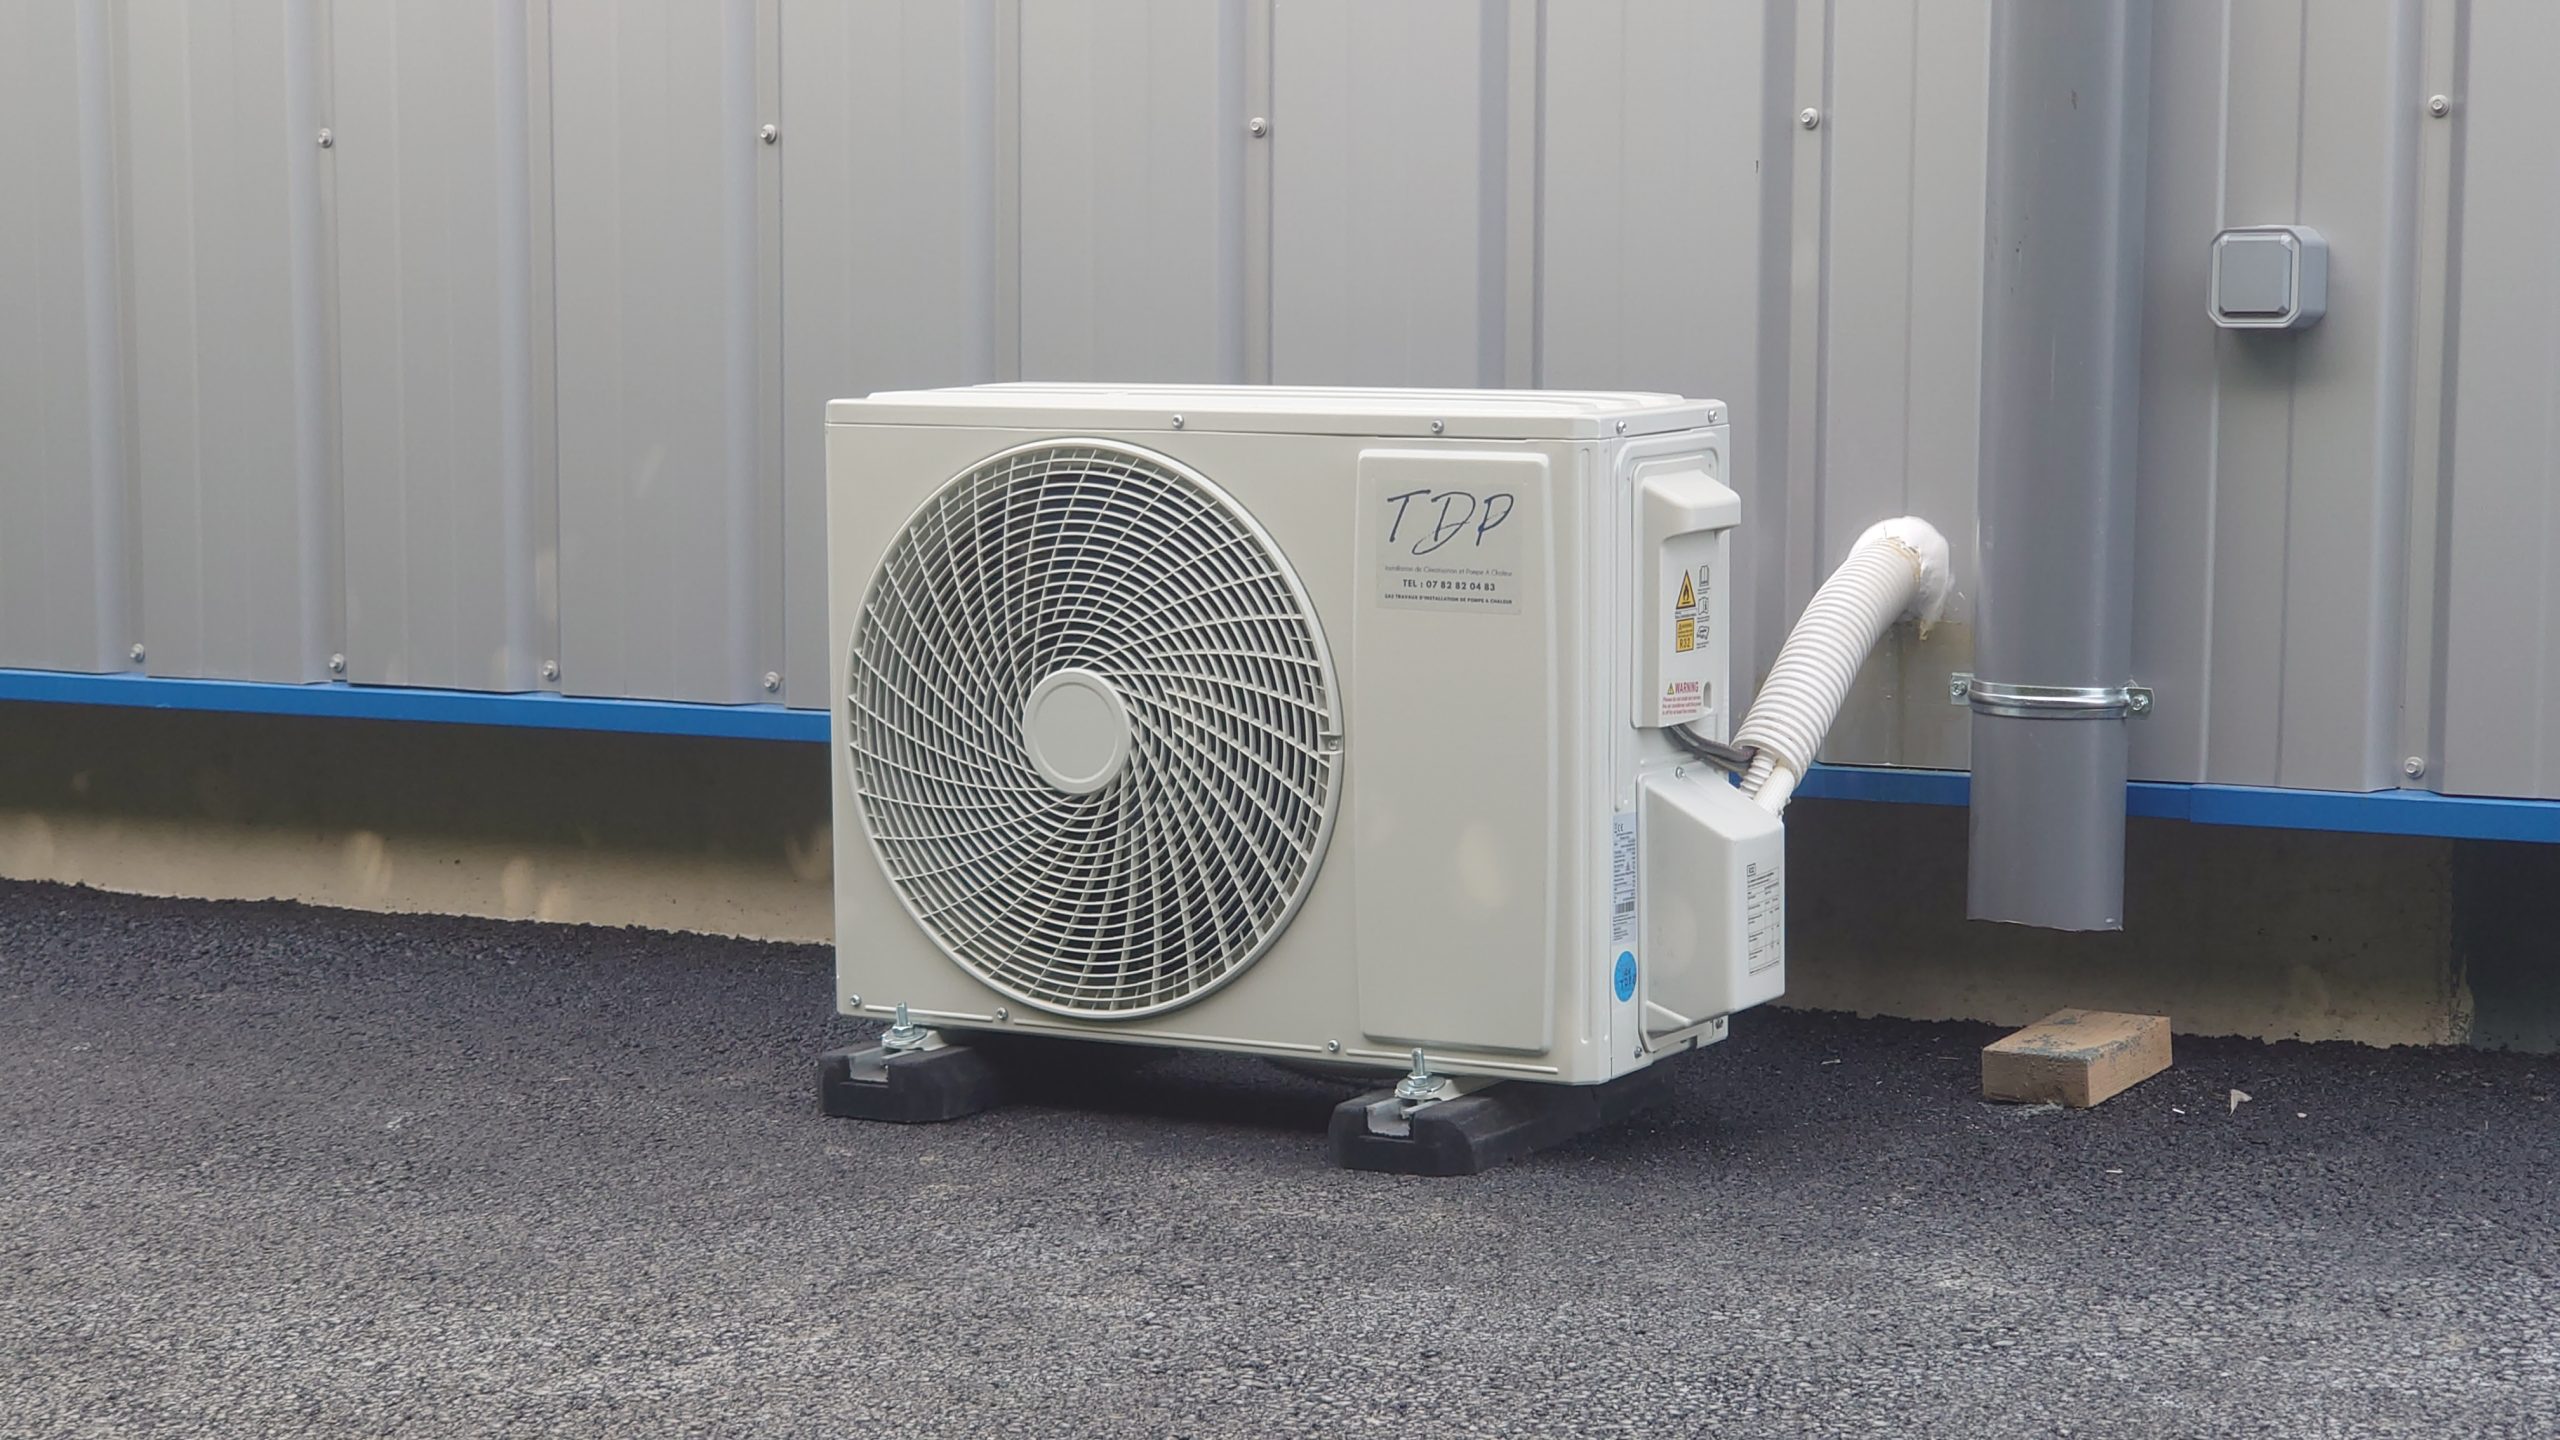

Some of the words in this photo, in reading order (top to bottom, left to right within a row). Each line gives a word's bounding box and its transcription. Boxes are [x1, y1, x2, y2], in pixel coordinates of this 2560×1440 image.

[1387, 489, 1514, 555] TDP
[1403, 579, 1417, 588] TEL
[1426, 580, 1438, 589] 07
[1441, 580, 1452, 590] 82
[1455, 581, 1467, 590] 82
[1469, 582, 1481, 591] 04
[1484, 582, 1496, 591] 83
[1679, 637, 1691, 649] R32
[1675, 681, 1699, 694] WARNING
